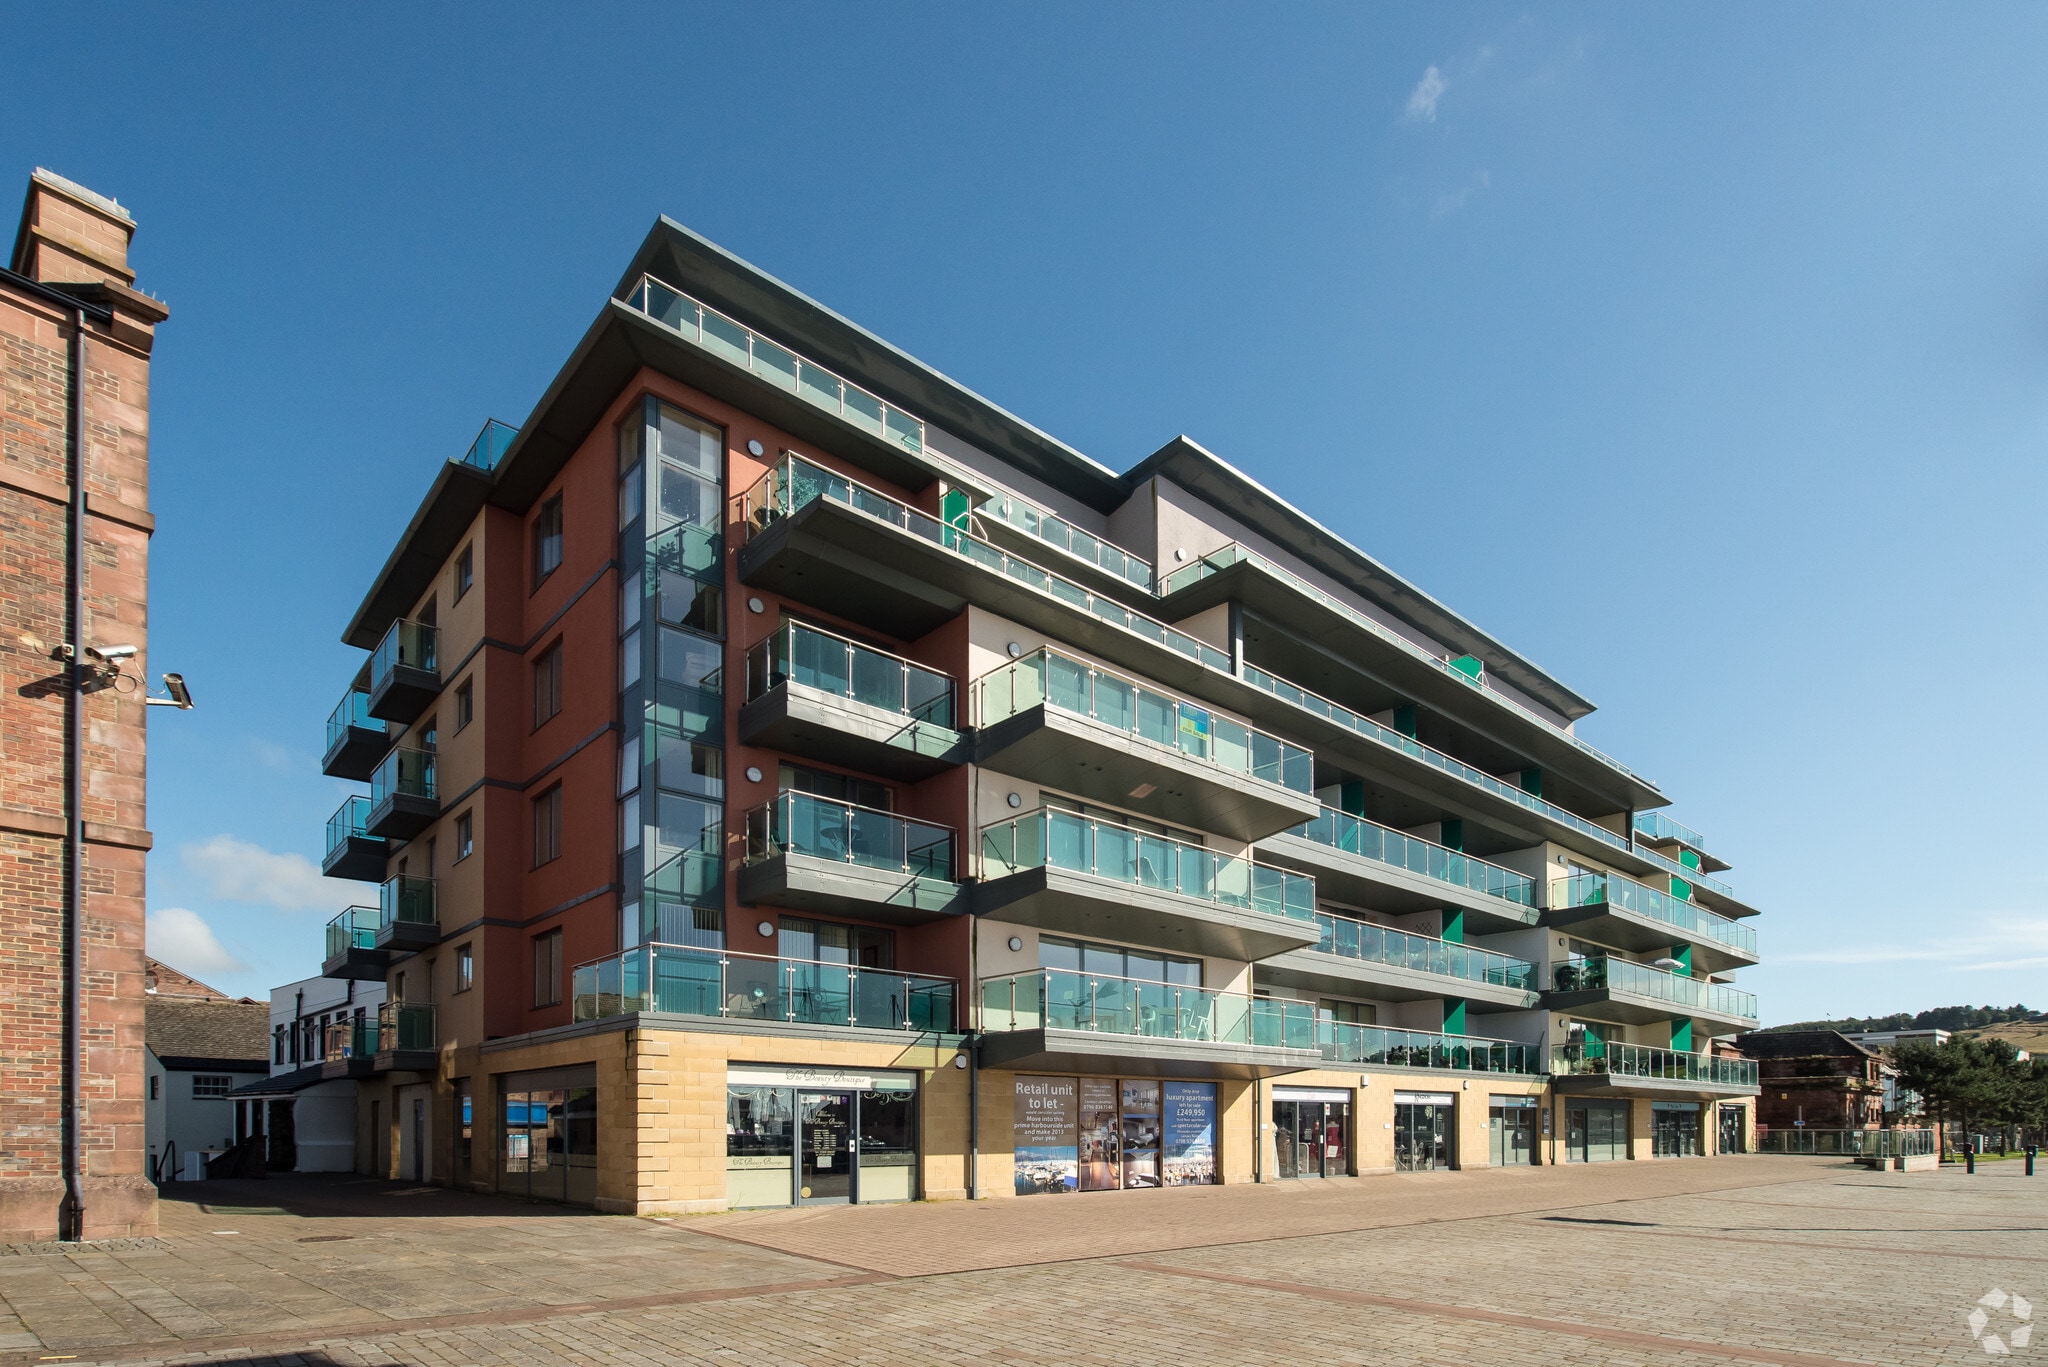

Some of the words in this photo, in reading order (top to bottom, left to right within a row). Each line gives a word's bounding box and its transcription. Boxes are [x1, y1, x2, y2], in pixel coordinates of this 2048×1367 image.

[803, 1068, 832, 1086] Beauty
[833, 1070, 866, 1085] Boutique
[1016, 1083, 1048, 1095] Retail
[1051, 1084, 1073, 1095] unit
[1028, 1097, 1041, 1109] to
[1043, 1097, 1058, 1109] let
